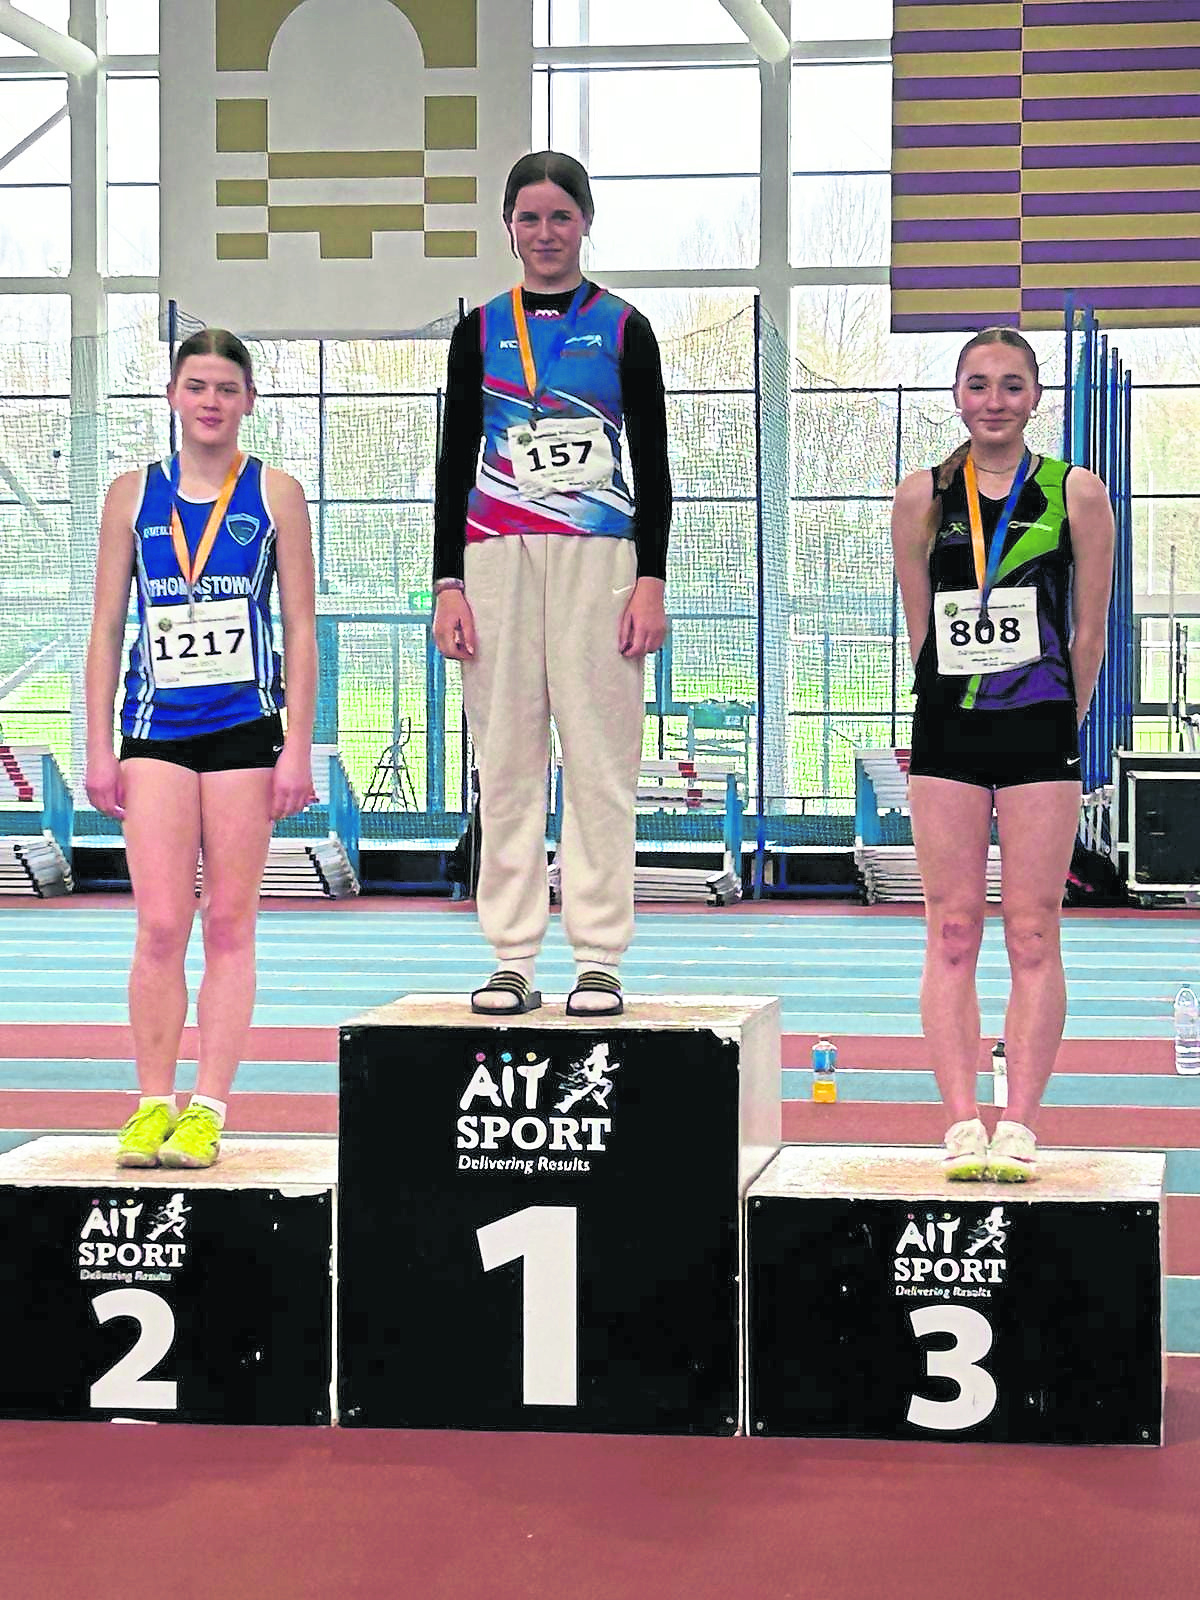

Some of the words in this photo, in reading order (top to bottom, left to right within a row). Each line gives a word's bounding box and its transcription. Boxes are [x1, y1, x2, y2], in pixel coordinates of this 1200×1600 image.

[526, 440, 593, 472] 157
[154, 628, 245, 661] 1217
[950, 617, 1021, 647] 808
[456, 1115, 612, 1152] SPORT
[458, 1154, 535, 1175] Delivering
[537, 1156, 591, 1172] Results
[78, 1242, 187, 1267] SPORT
[893, 1257, 1007, 1283] SPORT
[475, 1205, 578, 1408] 1
[89, 1287, 178, 1410] 2
[906, 1304, 998, 1430] 3
